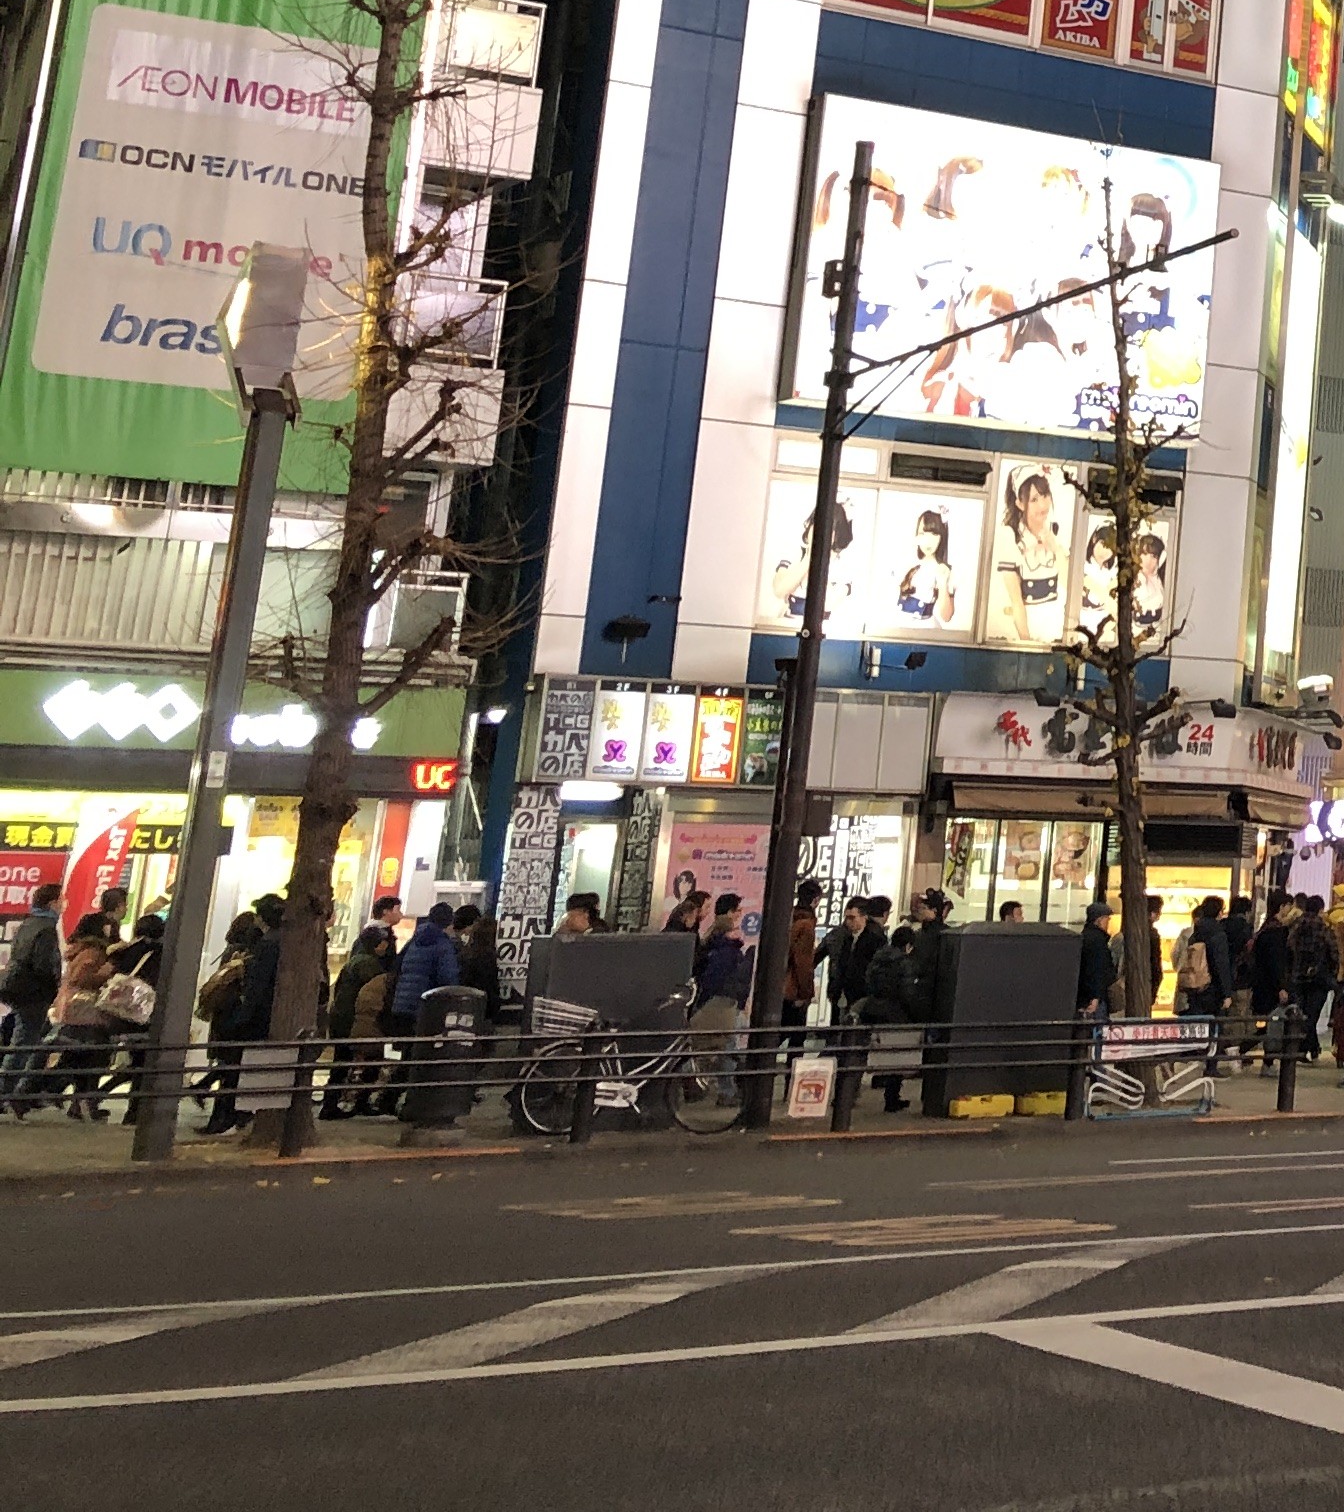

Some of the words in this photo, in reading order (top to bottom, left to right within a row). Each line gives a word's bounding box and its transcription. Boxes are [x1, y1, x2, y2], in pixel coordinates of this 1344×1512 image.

[1055, 29, 1101, 48] AKIBA
[223, 76, 356, 124] MOBILE
[120, 144, 195, 176] OCN
[200, 155, 298, 189] モバイル
[302, 170, 366, 199] ONE
[92, 217, 173, 266] UQ
[181, 238, 334, 279] moe
[101, 304, 222, 356] bras
[546, 714, 590, 729] TCG
[1189, 723, 1215, 742] 24
[1186, 740, 1213, 757] 時間
[512, 834, 557, 848] TCG
